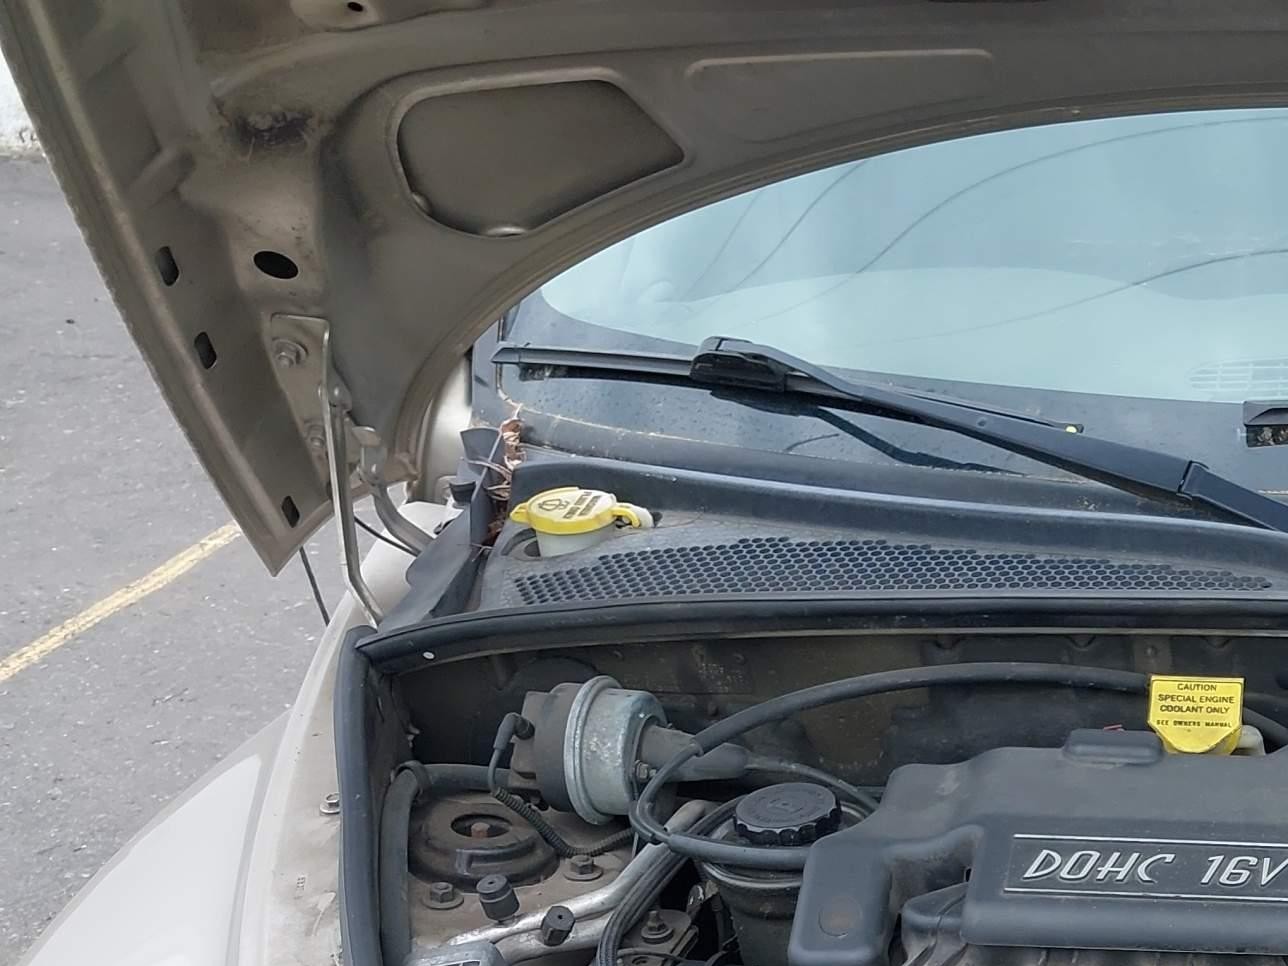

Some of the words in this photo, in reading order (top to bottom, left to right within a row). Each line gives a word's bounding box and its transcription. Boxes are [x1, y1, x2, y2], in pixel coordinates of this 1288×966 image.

[1177, 683, 1217, 691] CAUTION
[1158, 694, 1197, 703] SPECIAL
[1199, 695, 1236, 704] ENGINE
[1159, 704, 1203, 713] COOLANT
[1205, 706, 1230, 714] ONLY
[1022, 849, 1176, 884] DOHC
